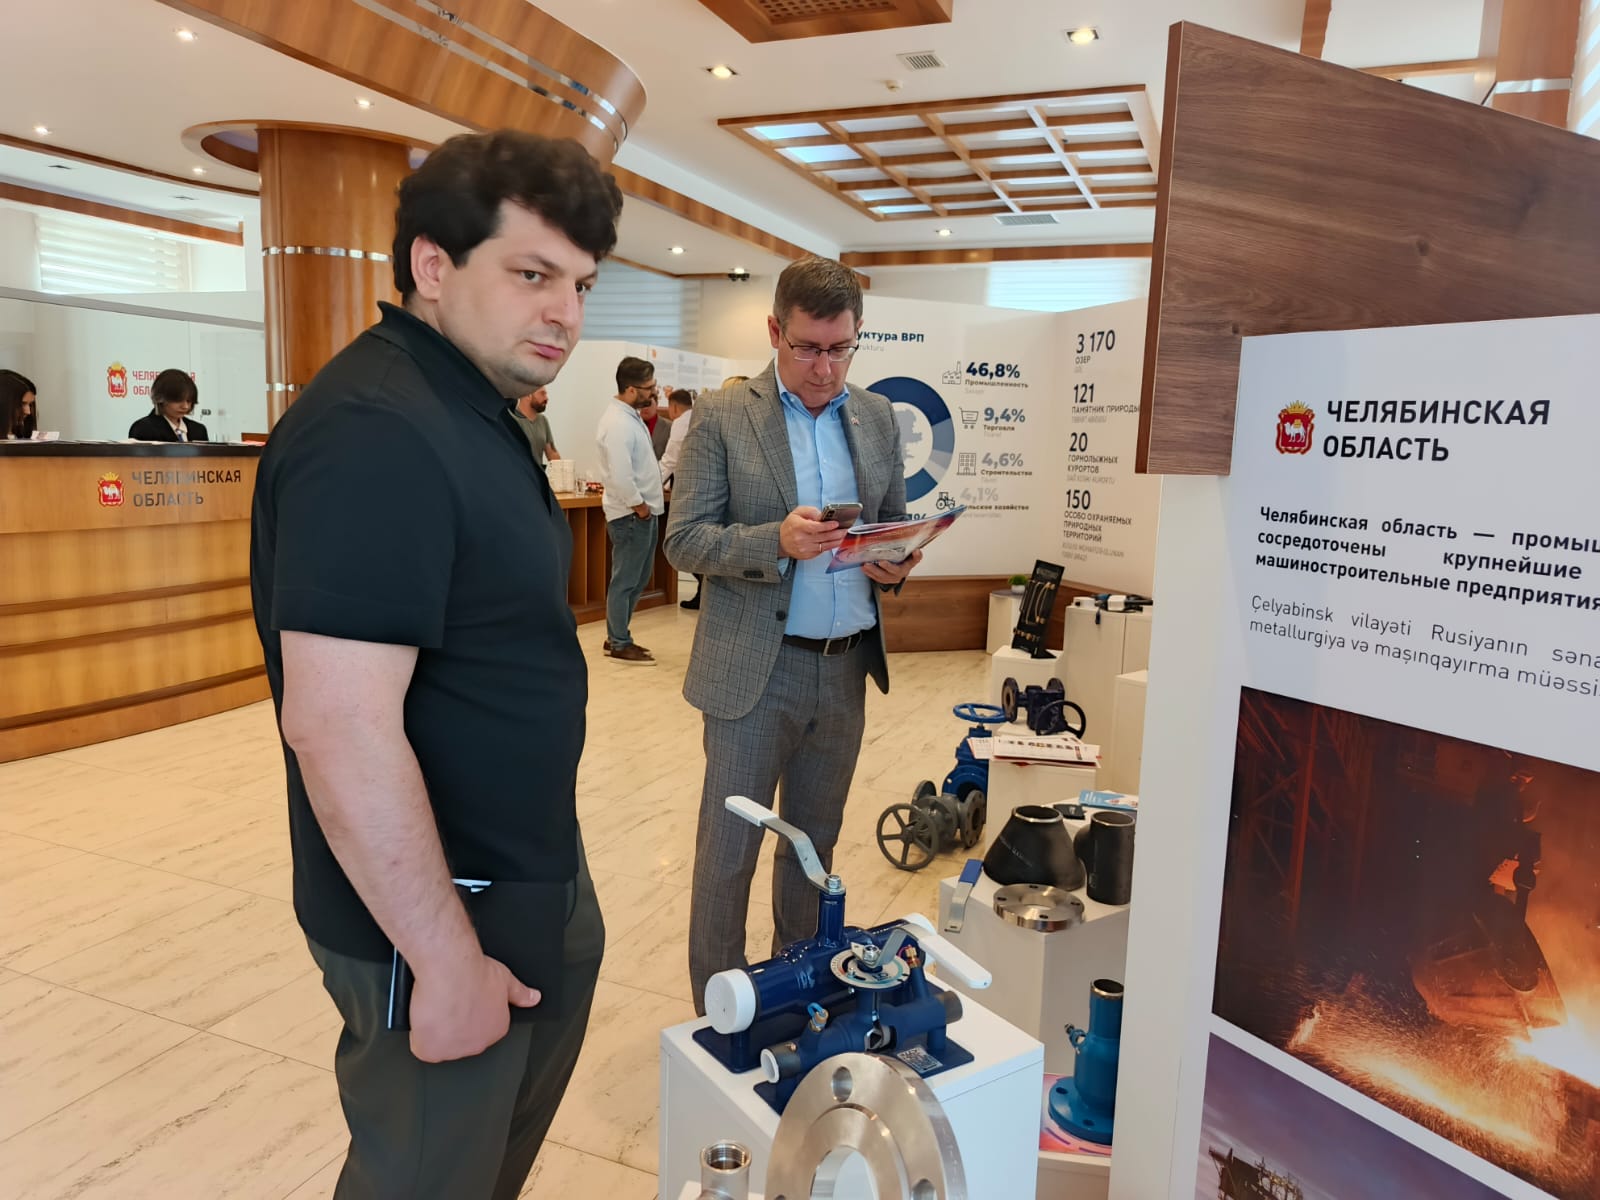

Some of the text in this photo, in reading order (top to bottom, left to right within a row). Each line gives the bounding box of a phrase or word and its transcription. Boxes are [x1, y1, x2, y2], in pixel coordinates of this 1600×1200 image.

[857, 331, 925, 343] уктура ВРП
[1076, 329, 1116, 354] 3 170
[965, 361, 1021, 380] 46,8%
[964, 379, 1029, 389] Промышленность
[1073, 383, 1095, 404] 121
[983, 407, 1027, 425] 9,4%
[1071, 405, 1105, 414] ПАМЯТНИК
[1326, 399, 1551, 426] ЧЕЛЯБИНСКАЯ
[983, 424, 1016, 432] Торговля
[1068, 431, 1089, 453] 20
[1322, 435, 1450, 462] ОБЛАСТЬ
[981, 452, 1024, 470] 4,6%
[1067, 465, 1100, 474] КУРОРТОВ
[133, 491, 205, 508] ОБЛАСТЬ
[960, 487, 999, 504] 4,1%
[1065, 489, 1091, 510] 150
[1063, 510, 1087, 520] ОСОБО
[1260, 506, 1369, 531] Челябинская
[1381, 518, 1458, 540] область
[1257, 531, 1583, 580] сосредоточены крупнейшие
[1255, 554, 1451, 591] машиностроительные
[1251, 595, 1334, 623] Çelyabinsk
[1350, 612, 1412, 637] vilayəti
[1431, 623, 1529, 657] Rusiyanın
[1250, 620, 1600, 697] metallurgiya və maşınqayırma müəssi
